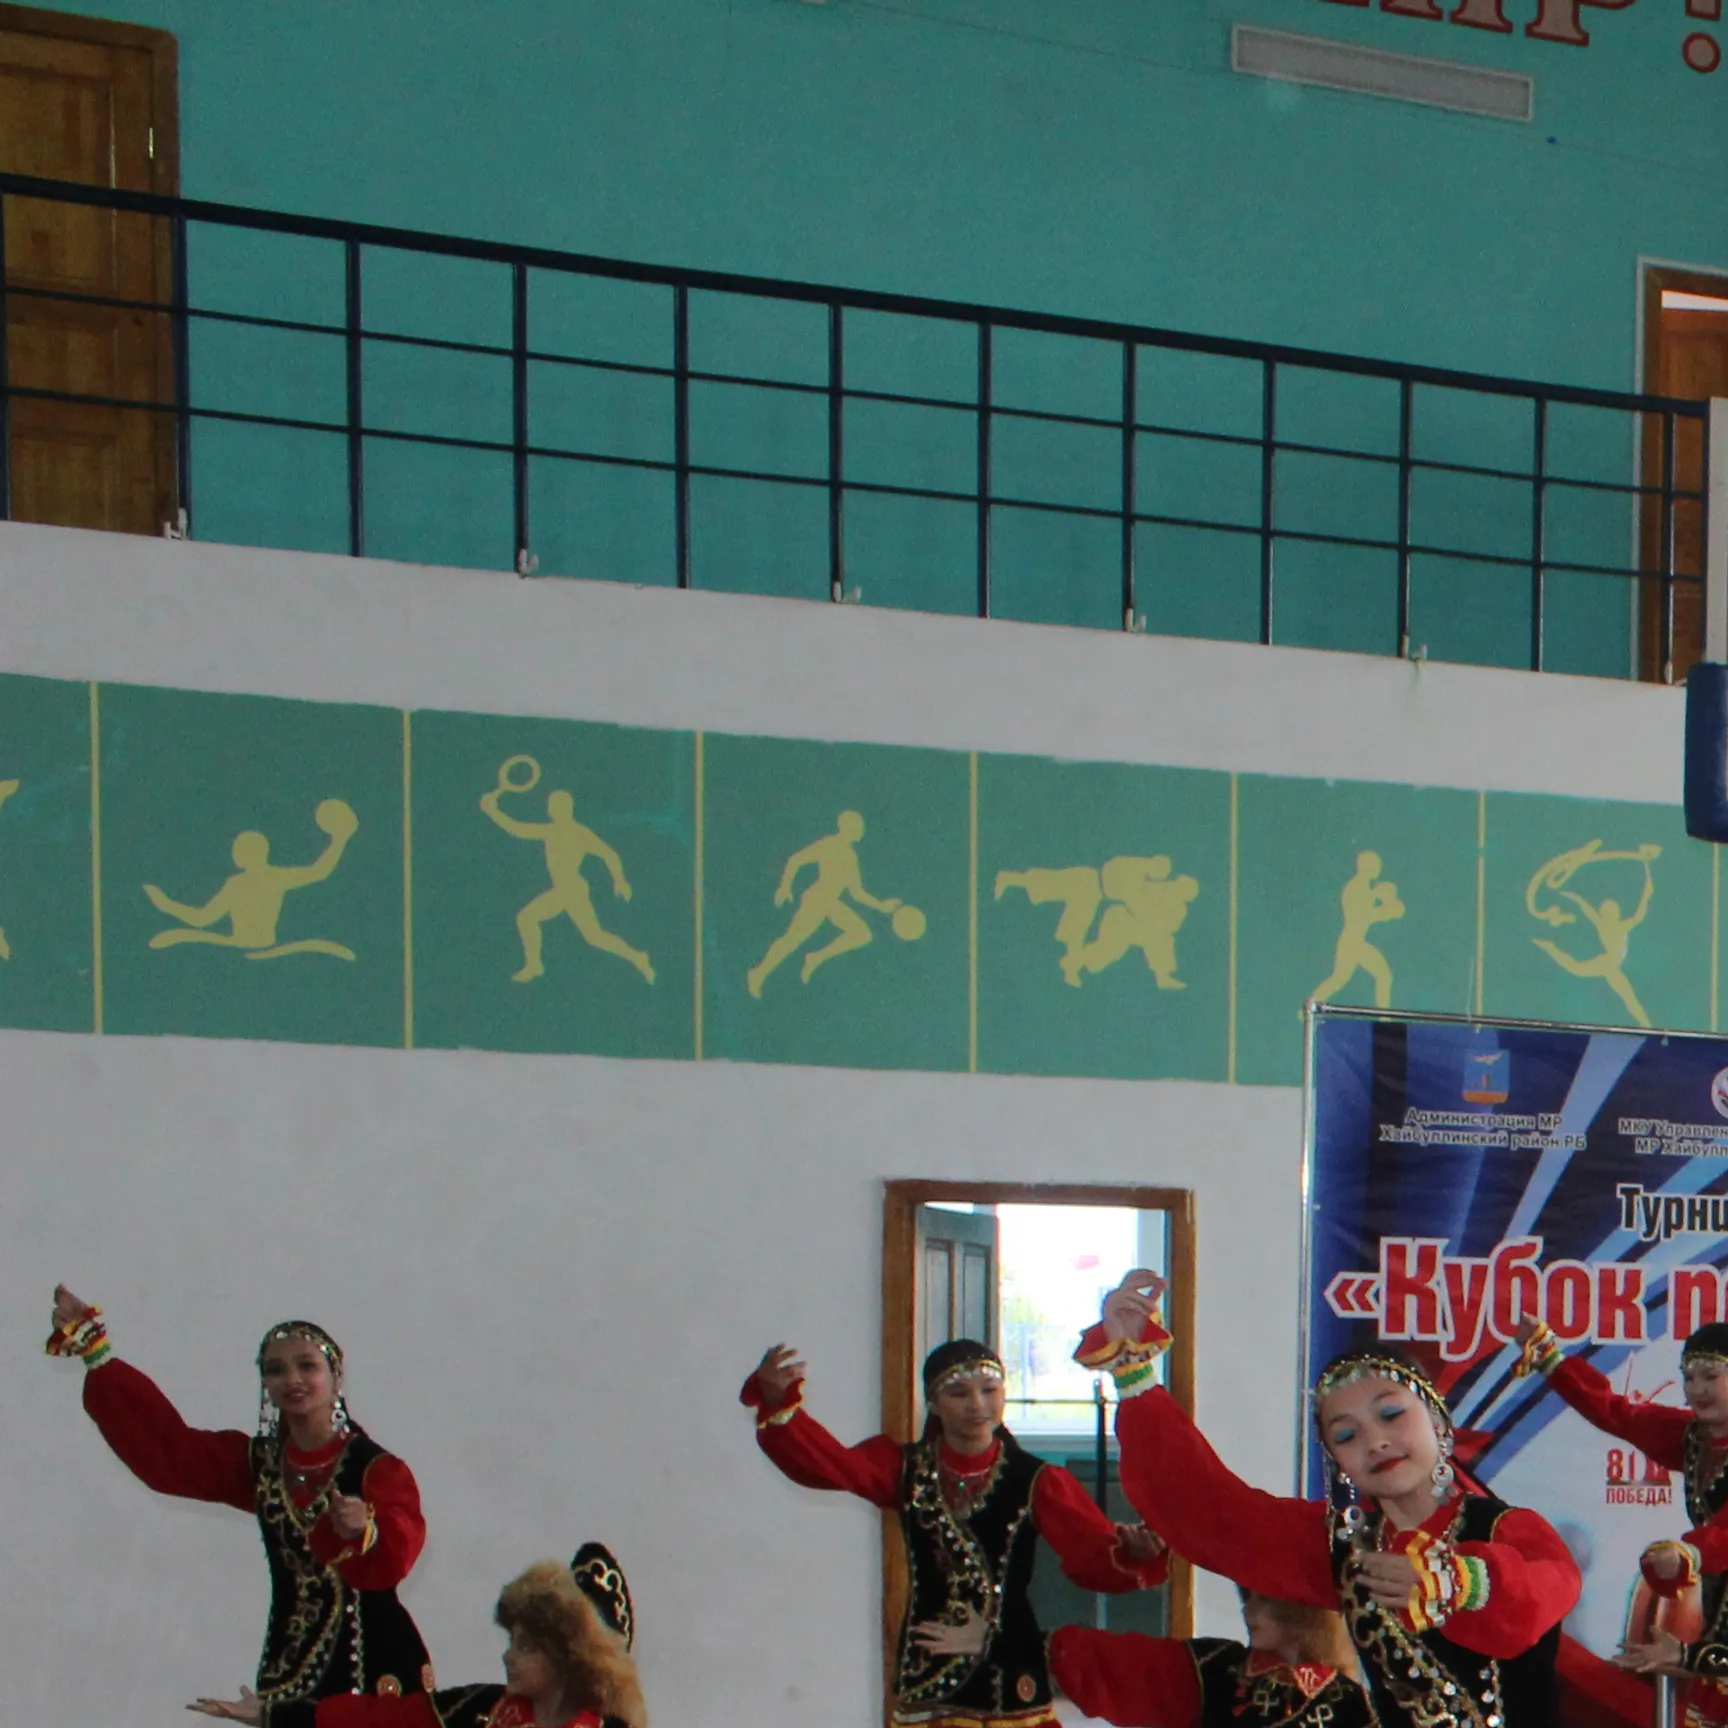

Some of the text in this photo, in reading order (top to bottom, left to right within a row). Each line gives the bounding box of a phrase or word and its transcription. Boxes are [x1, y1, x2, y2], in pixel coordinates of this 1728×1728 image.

[1404, 1107, 1563, 1130] Администрация МР
[1511, 1131, 1559, 1150] район
[1563, 1132, 1588, 1150] РБ
[1635, 1138, 1661, 1154] МР
[1327, 1238, 1645, 1360] «Кубок
[1606, 1487, 1672, 1507] ПОБЕДА!
